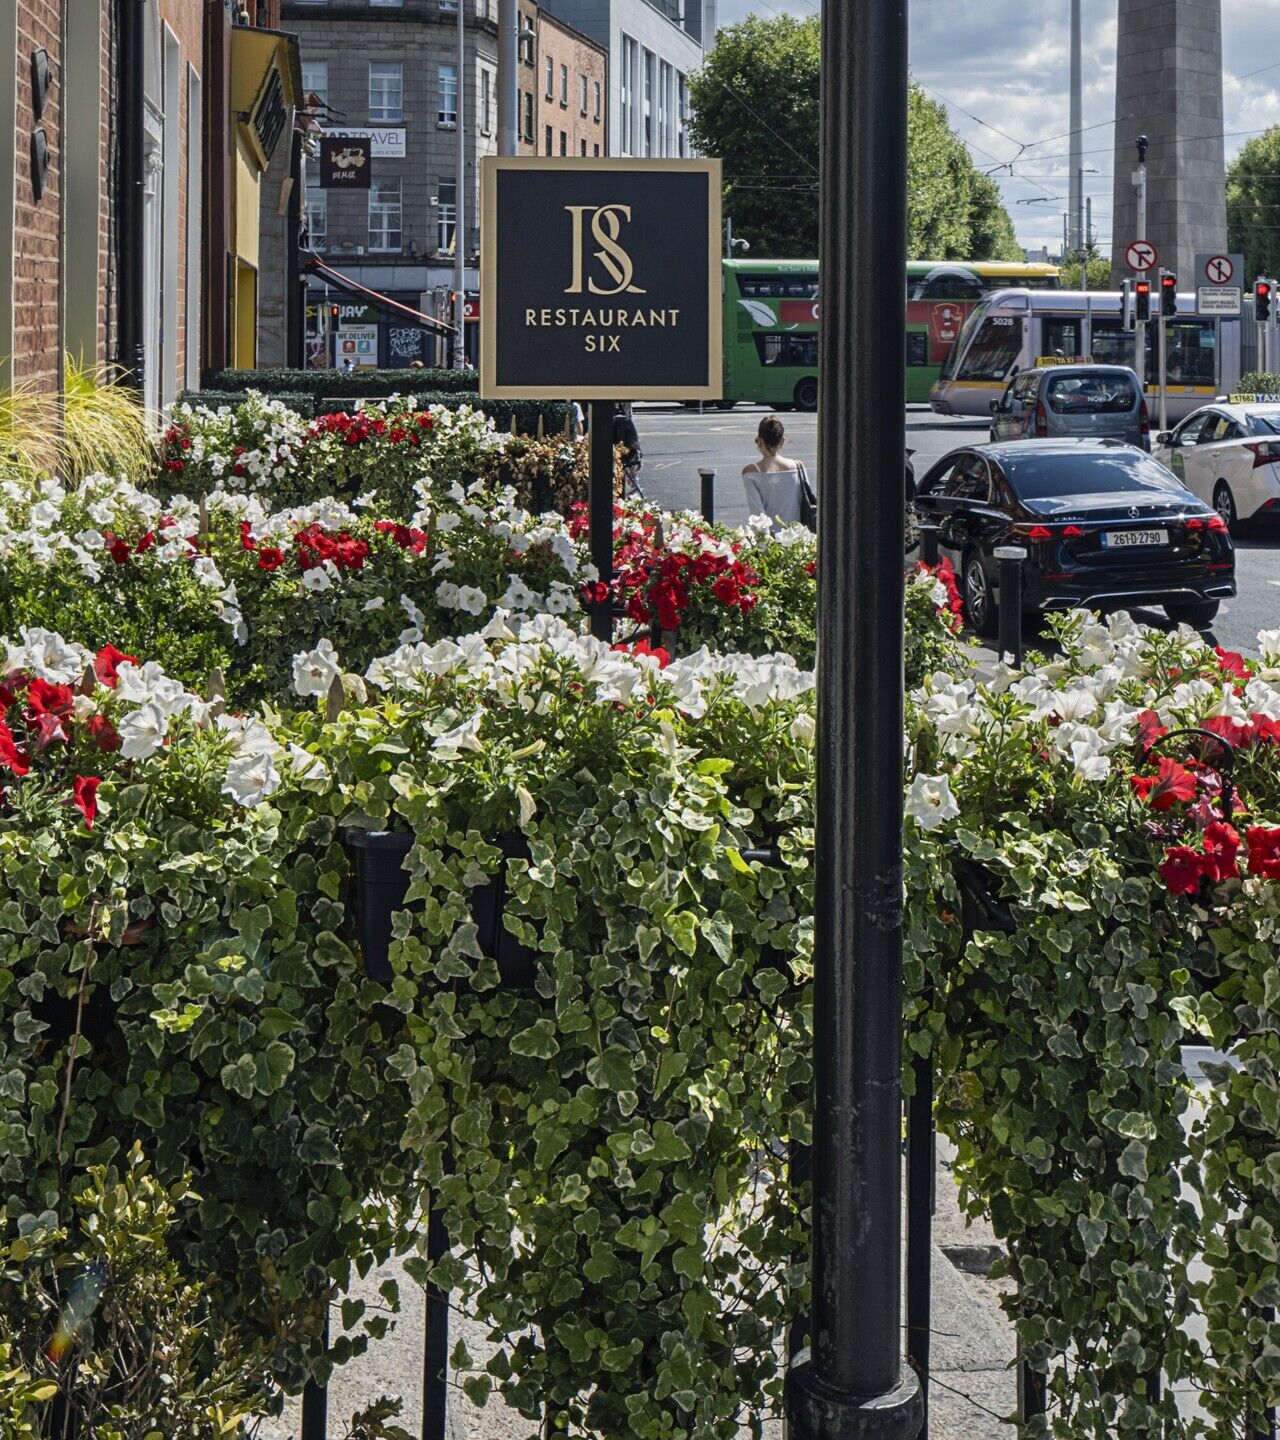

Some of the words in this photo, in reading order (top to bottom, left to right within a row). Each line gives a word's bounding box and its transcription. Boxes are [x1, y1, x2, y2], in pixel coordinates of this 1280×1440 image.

[525, 309, 680, 326] RESTAURANT
[585, 335, 620, 352] SIX
[1257, 394, 1280, 402] TAXI
[1113, 533, 1161, 545] 261-D-2790
